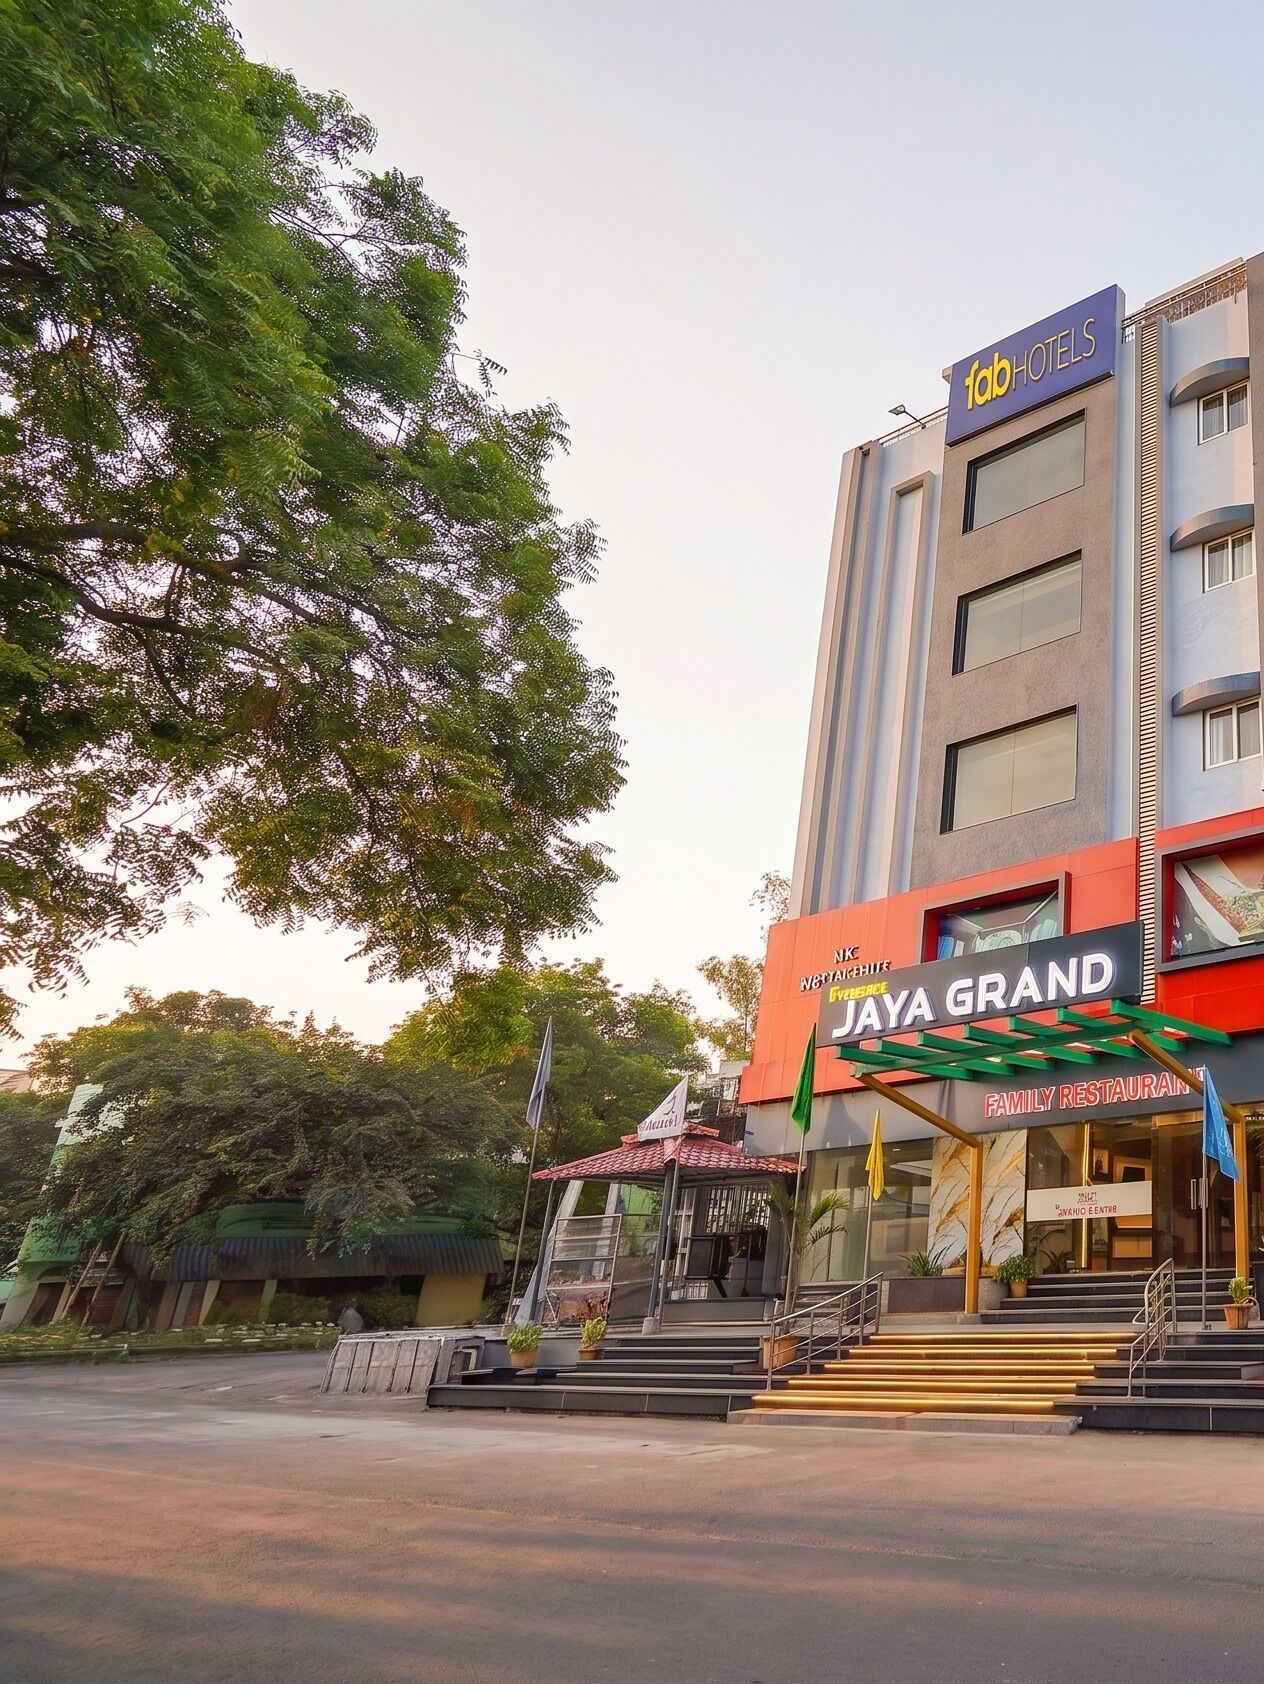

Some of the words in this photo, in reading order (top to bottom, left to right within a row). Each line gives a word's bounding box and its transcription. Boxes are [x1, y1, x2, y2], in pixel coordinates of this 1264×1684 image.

[832, 986, 938, 1039] JAYA
[946, 951, 1114, 1016] GRAND
[984, 1085, 1055, 1118] FAMILY
